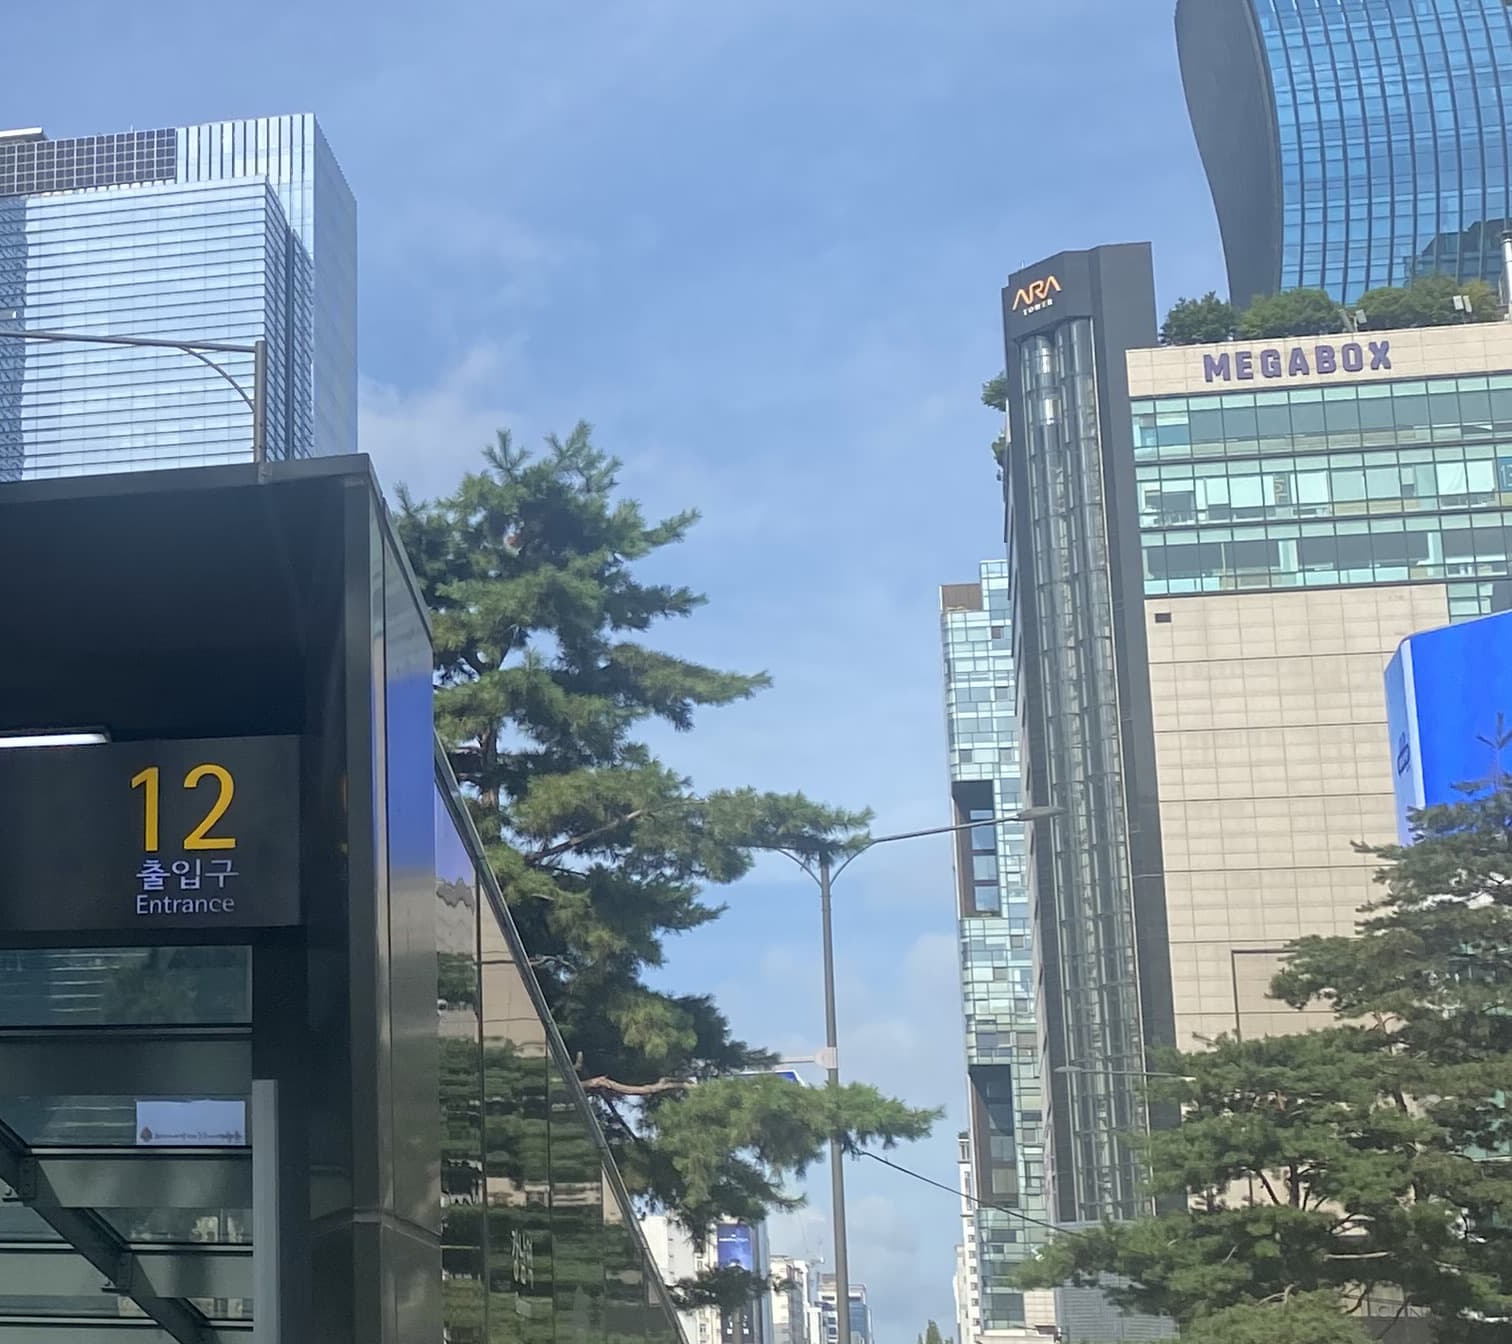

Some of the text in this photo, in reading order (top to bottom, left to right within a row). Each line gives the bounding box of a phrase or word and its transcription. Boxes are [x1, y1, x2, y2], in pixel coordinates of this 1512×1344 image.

[1203, 339, 1392, 384] MEGABOX
[129, 763, 237, 852] 12
[135, 858, 240, 892] 출입구
[135, 892, 236, 916] Entrance
